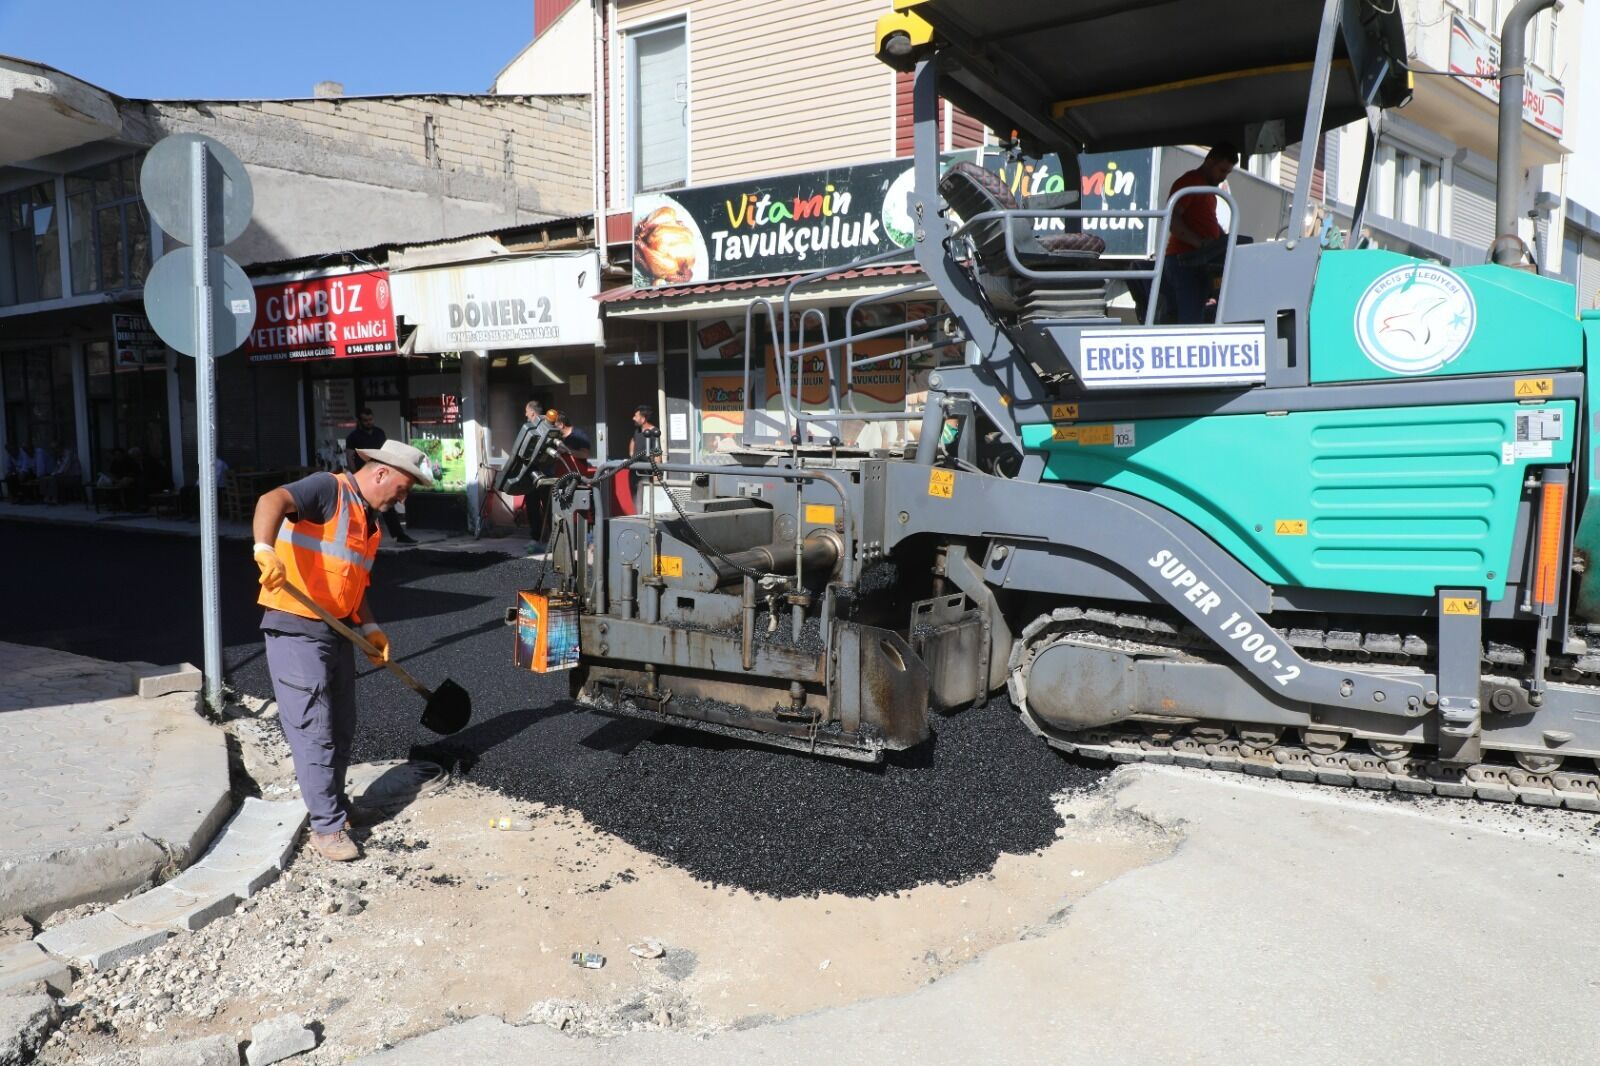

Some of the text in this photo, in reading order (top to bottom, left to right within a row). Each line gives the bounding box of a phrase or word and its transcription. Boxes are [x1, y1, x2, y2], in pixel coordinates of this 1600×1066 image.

[726, 184, 852, 229] Vitamin
[711, 212, 880, 262] Tavukçuluk
[266, 281, 362, 322] GÜRBÜZ
[448, 294, 553, 328] DÖNER-2
[249, 319, 387, 348] VETERİNER KLİNİĞİ
[1087, 340, 1260, 373] ERCİŞ BELEDİYESİ
[1116, 434, 1129, 446] 109
[1148, 550, 1301, 687] SUPER 1900-2
